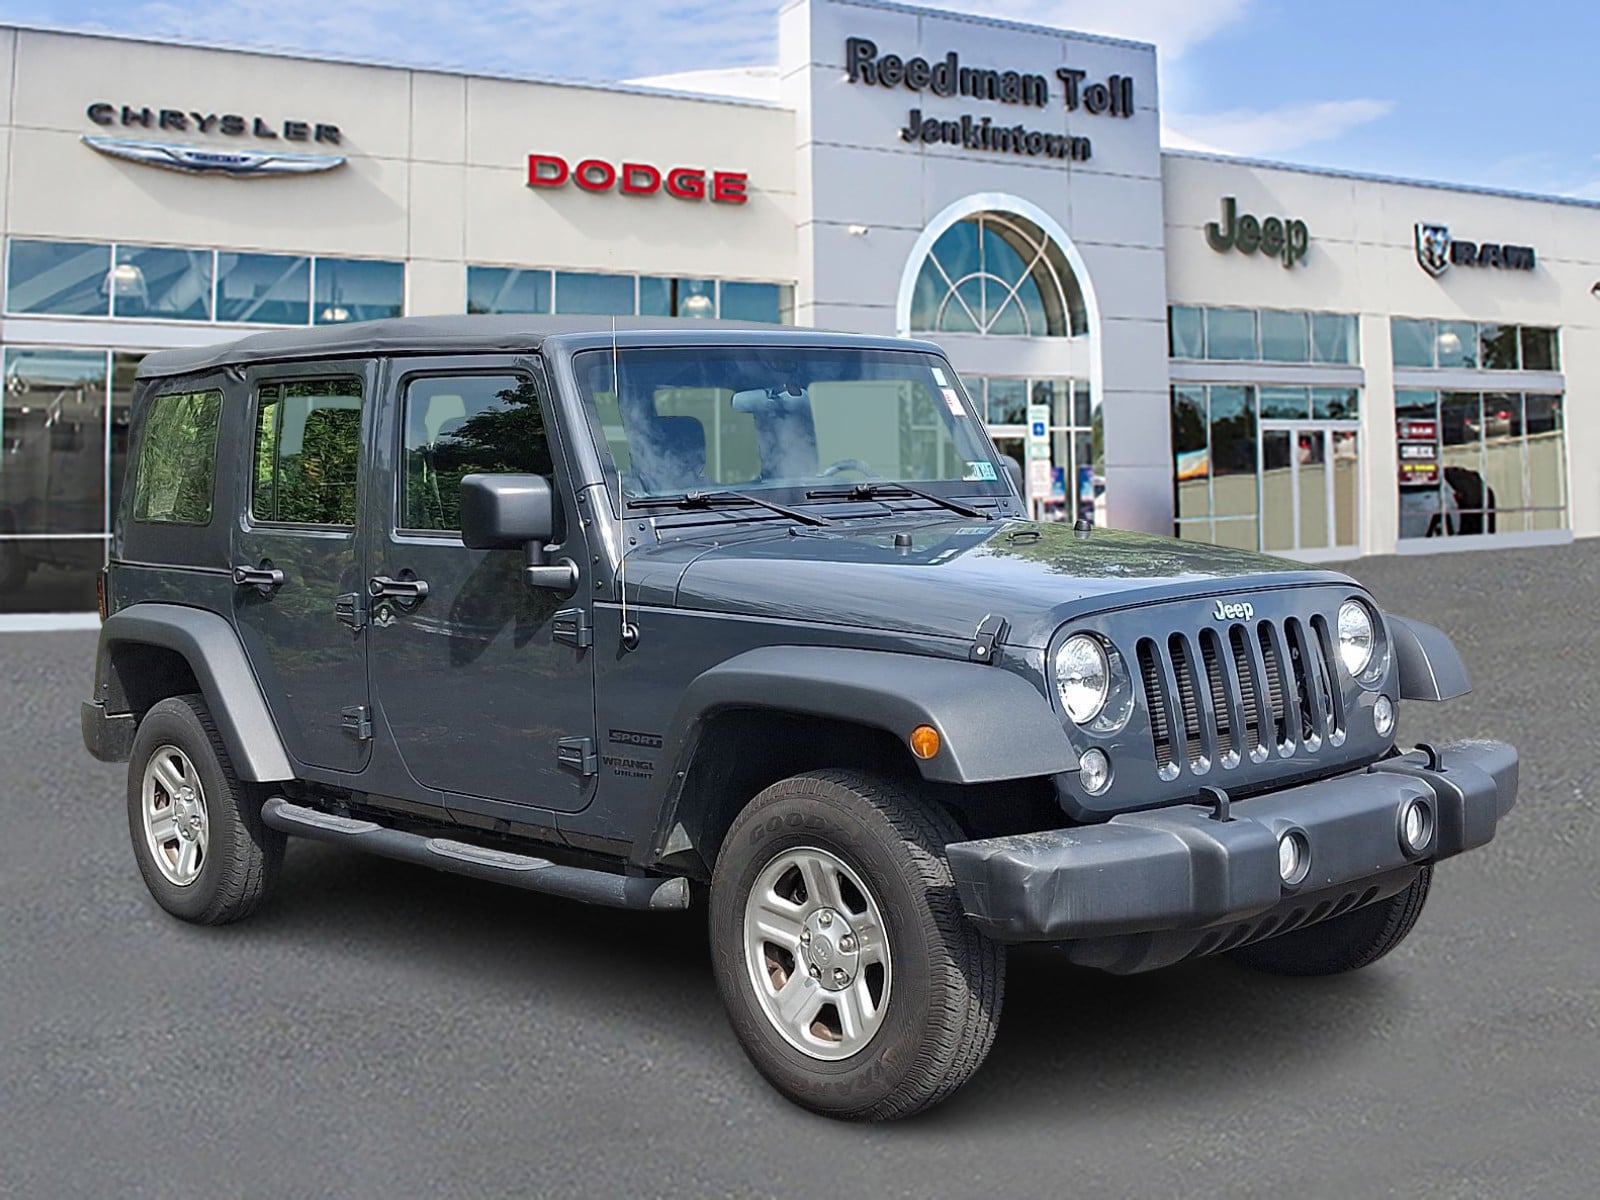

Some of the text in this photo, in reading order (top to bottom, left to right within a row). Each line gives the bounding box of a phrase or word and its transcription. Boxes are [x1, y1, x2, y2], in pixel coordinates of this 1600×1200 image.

[846, 37, 1134, 118] Reedman Toll
[86, 102, 343, 145] CHRYSLER
[901, 109, 1091, 160] Jenkintown
[526, 154, 749, 205] DODGE
[1204, 196, 1308, 270] Jeep
[1450, 241, 1535, 271] RAM
[1212, 599, 1254, 622] Jeep
[610, 731, 661, 747] SPORT
[602, 755, 655, 771] WRANGL
